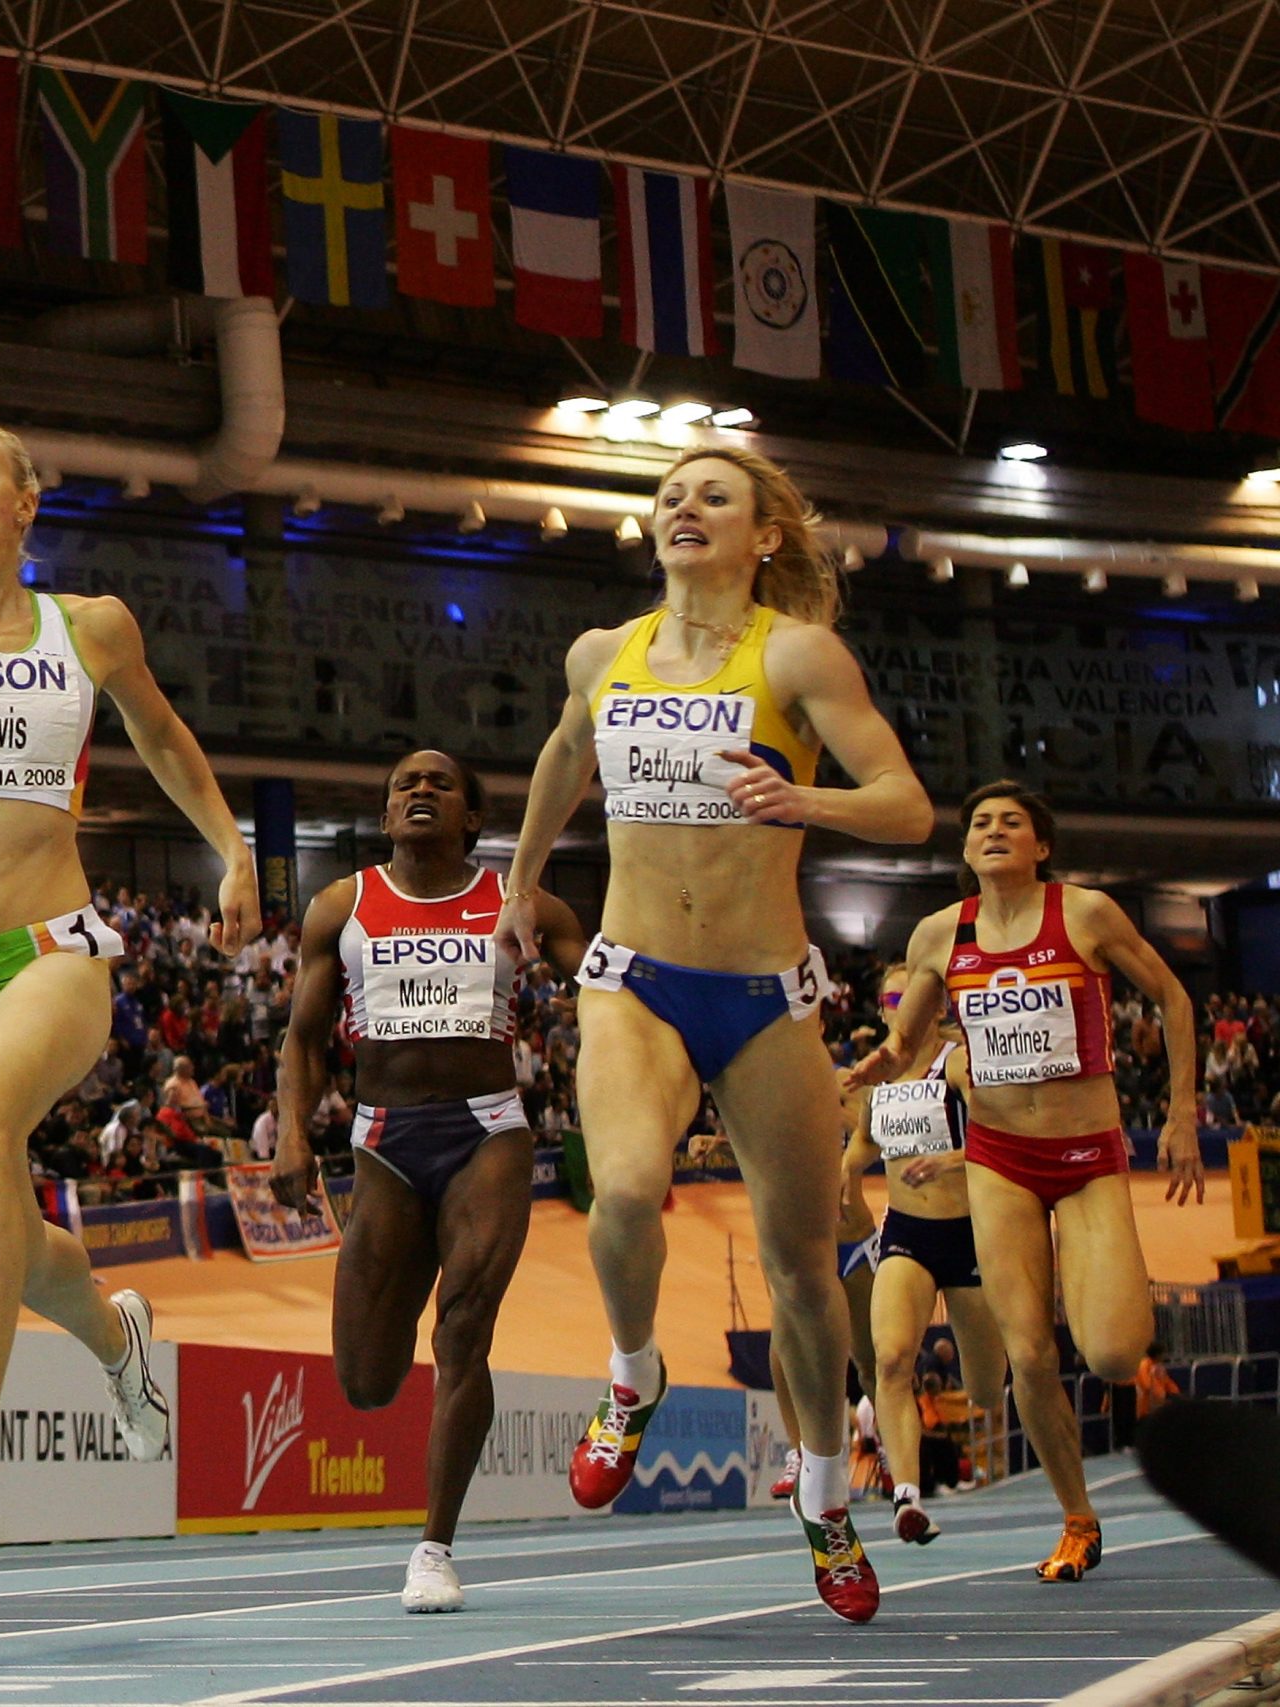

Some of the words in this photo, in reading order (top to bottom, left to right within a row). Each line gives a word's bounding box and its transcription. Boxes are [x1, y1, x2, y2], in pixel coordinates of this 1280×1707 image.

[607, 697, 743, 734] EPSON
[1055, 685, 1217, 717] VALENCIA
[23, 768, 66, 796] 2008
[629, 745, 704, 794] Petlyuk
[610, 802, 690, 821] VALENCIA
[68, 913, 100, 958] 1
[372, 938, 487, 966] EPSON
[586, 937, 615, 979] 5
[1027, 948, 1057, 966] ESP
[399, 977, 458, 1009] Mutola
[797, 957, 818, 1004] 5
[966, 985, 1063, 1017] EPSON
[374, 1019, 450, 1036] VALENCIA
[454, 1019, 486, 1034] 2008
[985, 1023, 1052, 1058] Martínez
[975, 1066, 1039, 1083] VALENCIA
[1041, 1061, 1075, 1076] 2008
[877, 1082, 939, 1105] EPSON
[880, 1111, 932, 1137] Meadows
[37, 1411, 65, 1461] DE
[241, 1365, 305, 1489] Vidal
[308, 1437, 386, 1495] Tiendas
